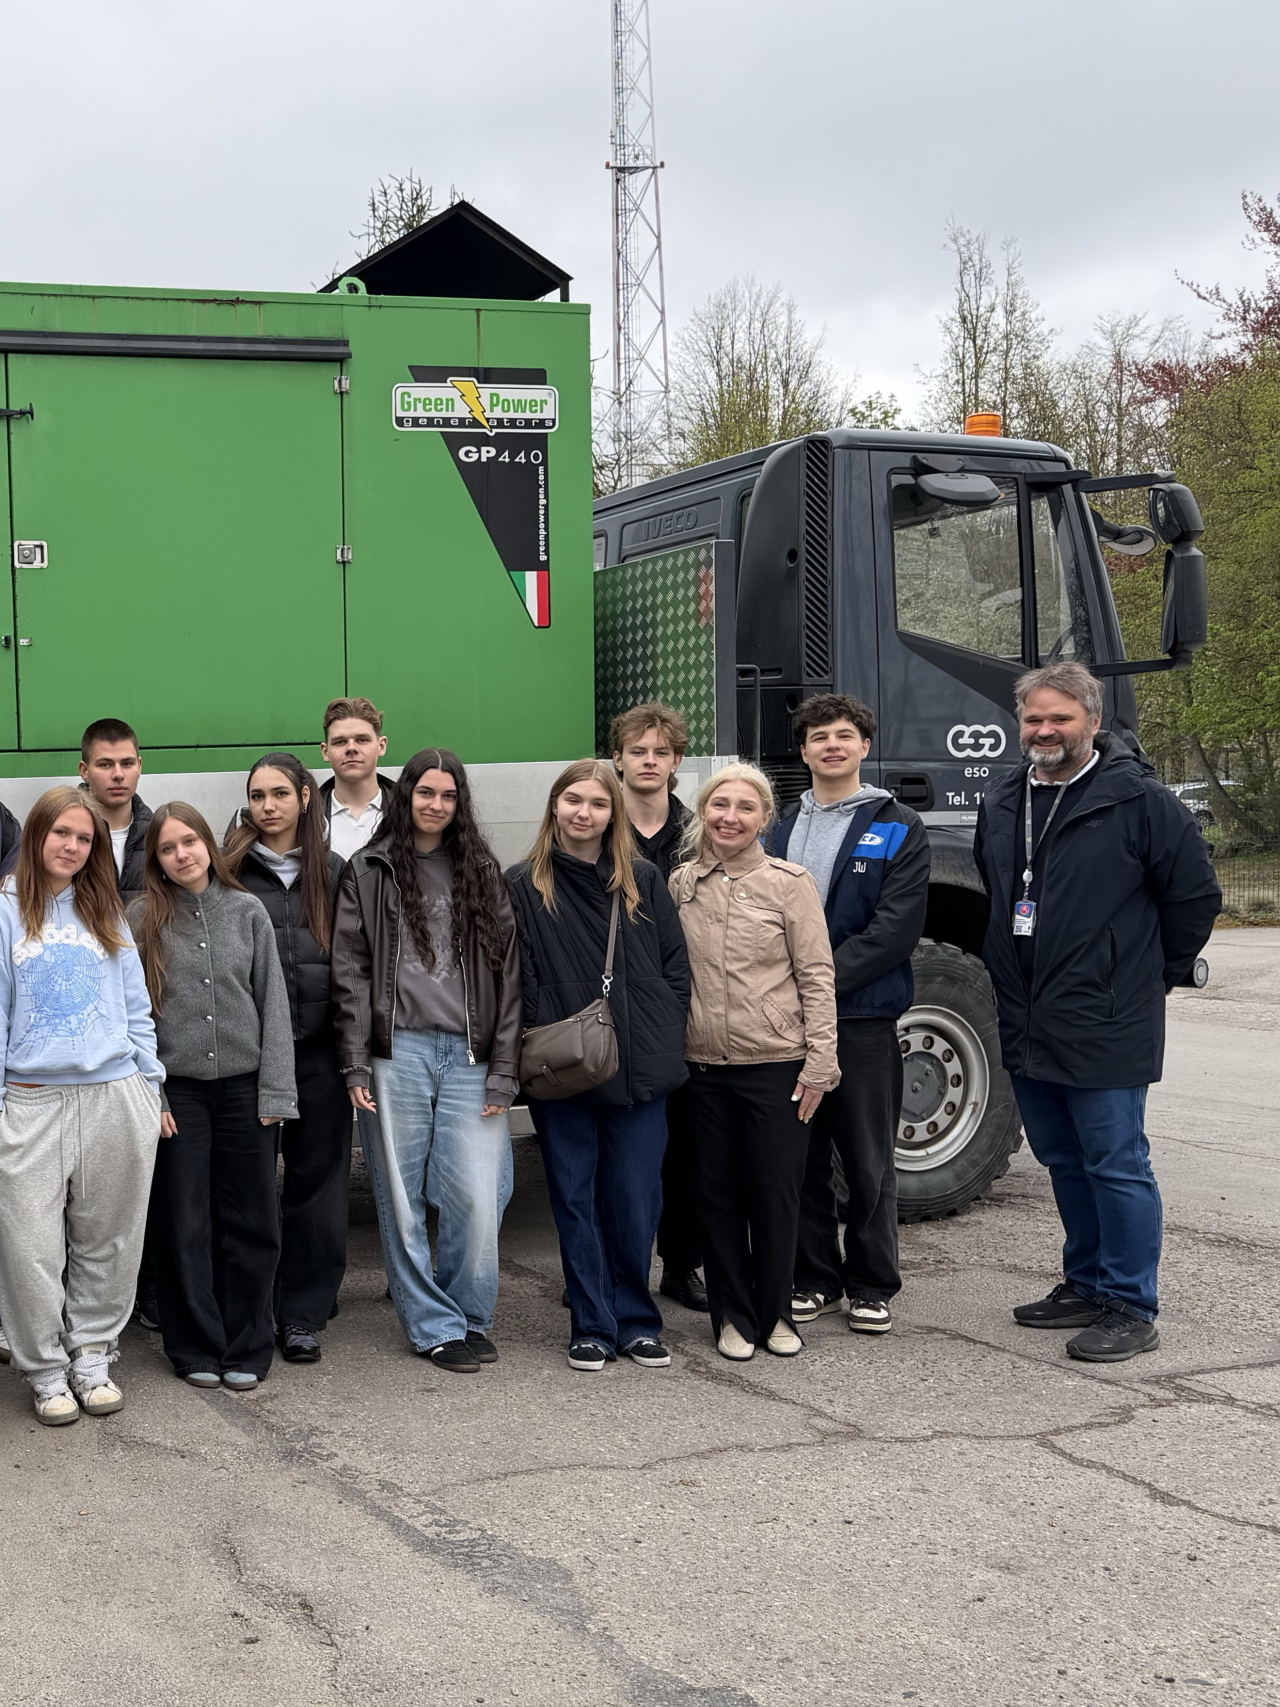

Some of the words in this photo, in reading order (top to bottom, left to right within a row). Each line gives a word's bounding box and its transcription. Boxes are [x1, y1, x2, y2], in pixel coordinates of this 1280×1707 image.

[400, 391, 455, 413] Green
[489, 392, 548, 414] Power
[403, 418, 553, 427] generators
[458, 446, 543, 464] GP440
[538, 466, 547, 561] greenpowergen.com
[643, 507, 698, 542] IVECO
[964, 766, 989, 778] eso
[946, 791, 969, 805] Tel.
[973, 792, 985, 805] 1
